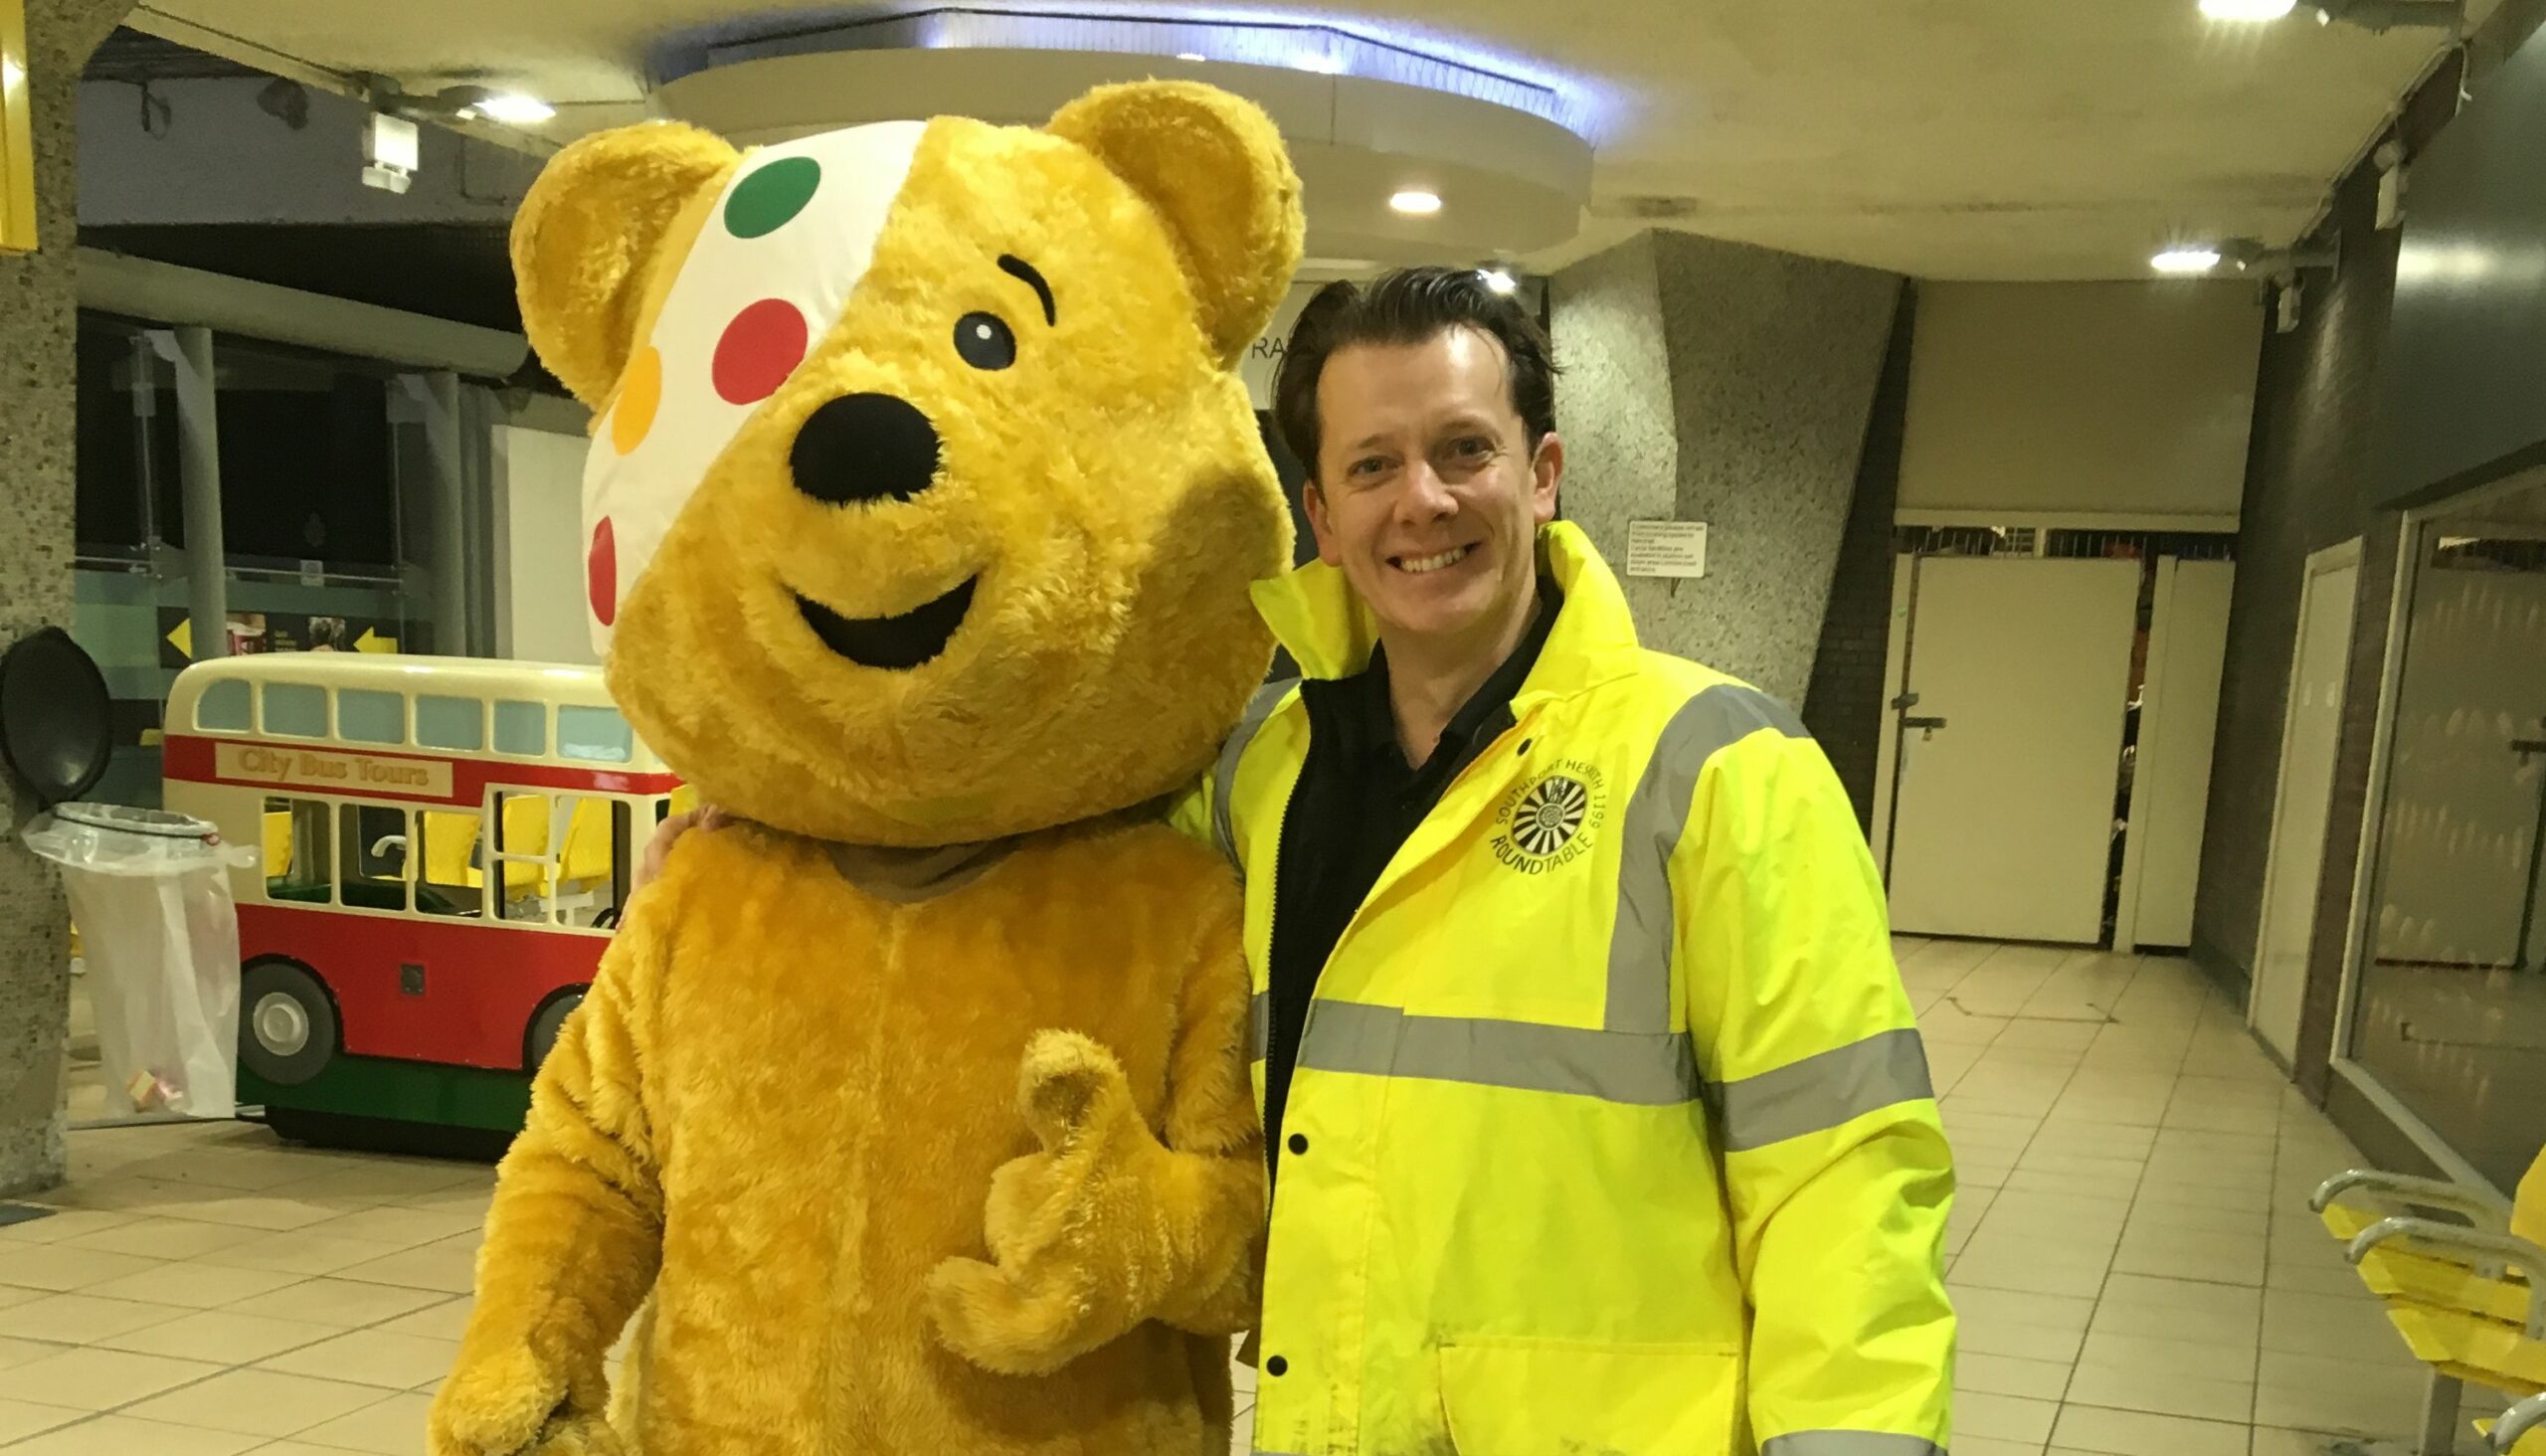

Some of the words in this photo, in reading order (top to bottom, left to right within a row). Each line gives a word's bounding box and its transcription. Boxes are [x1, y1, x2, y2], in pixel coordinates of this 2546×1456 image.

[238, 747, 292, 782] City
[298, 752, 348, 780] Bus
[354, 757, 430, 787] Tours
[1495, 758, 1563, 824] SOUTHPORT
[1588, 794, 1607, 829] 1199
[1490, 831, 1593, 875] ROUNDTABLE
